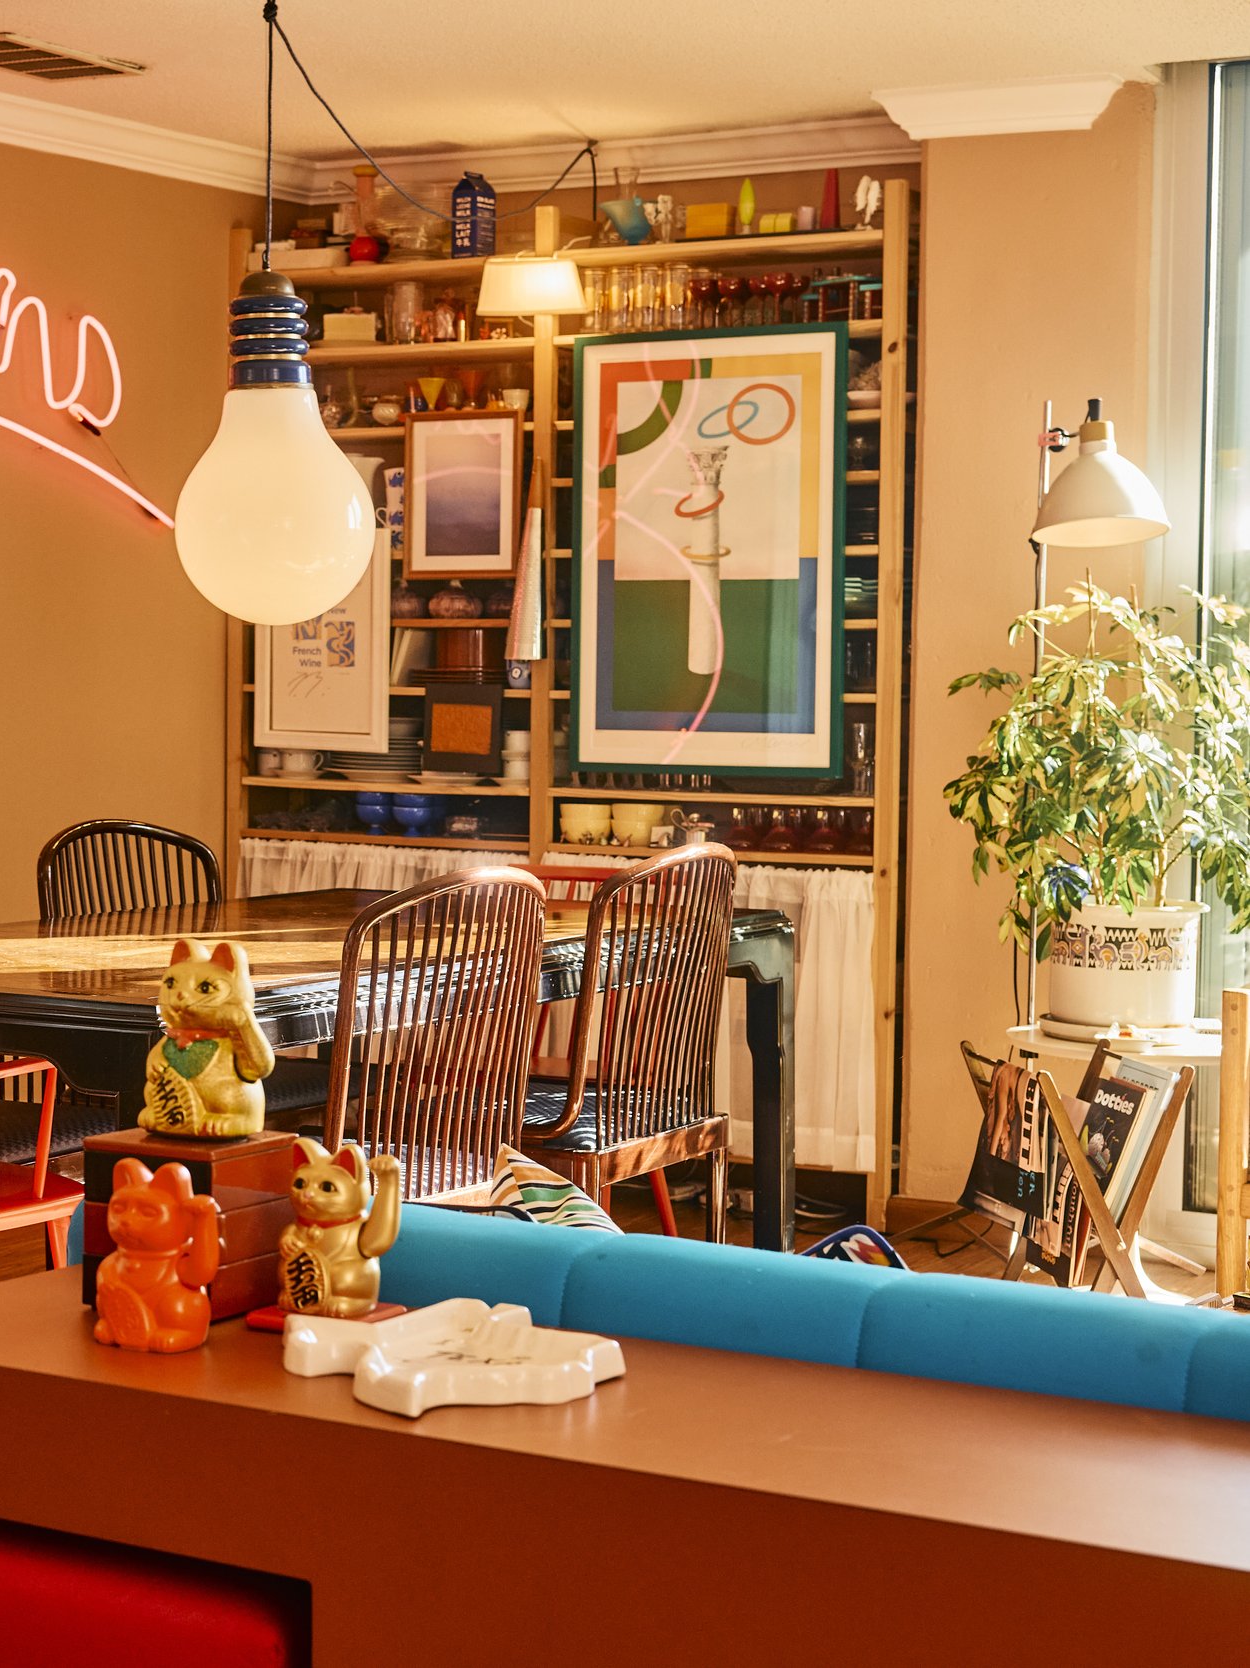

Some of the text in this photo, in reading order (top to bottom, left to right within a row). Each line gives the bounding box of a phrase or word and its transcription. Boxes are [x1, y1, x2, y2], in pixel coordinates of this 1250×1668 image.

[292, 646, 322, 655] French
[299, 659, 322, 667] Wine
[1022, 1077, 1038, 1166] BUTT
